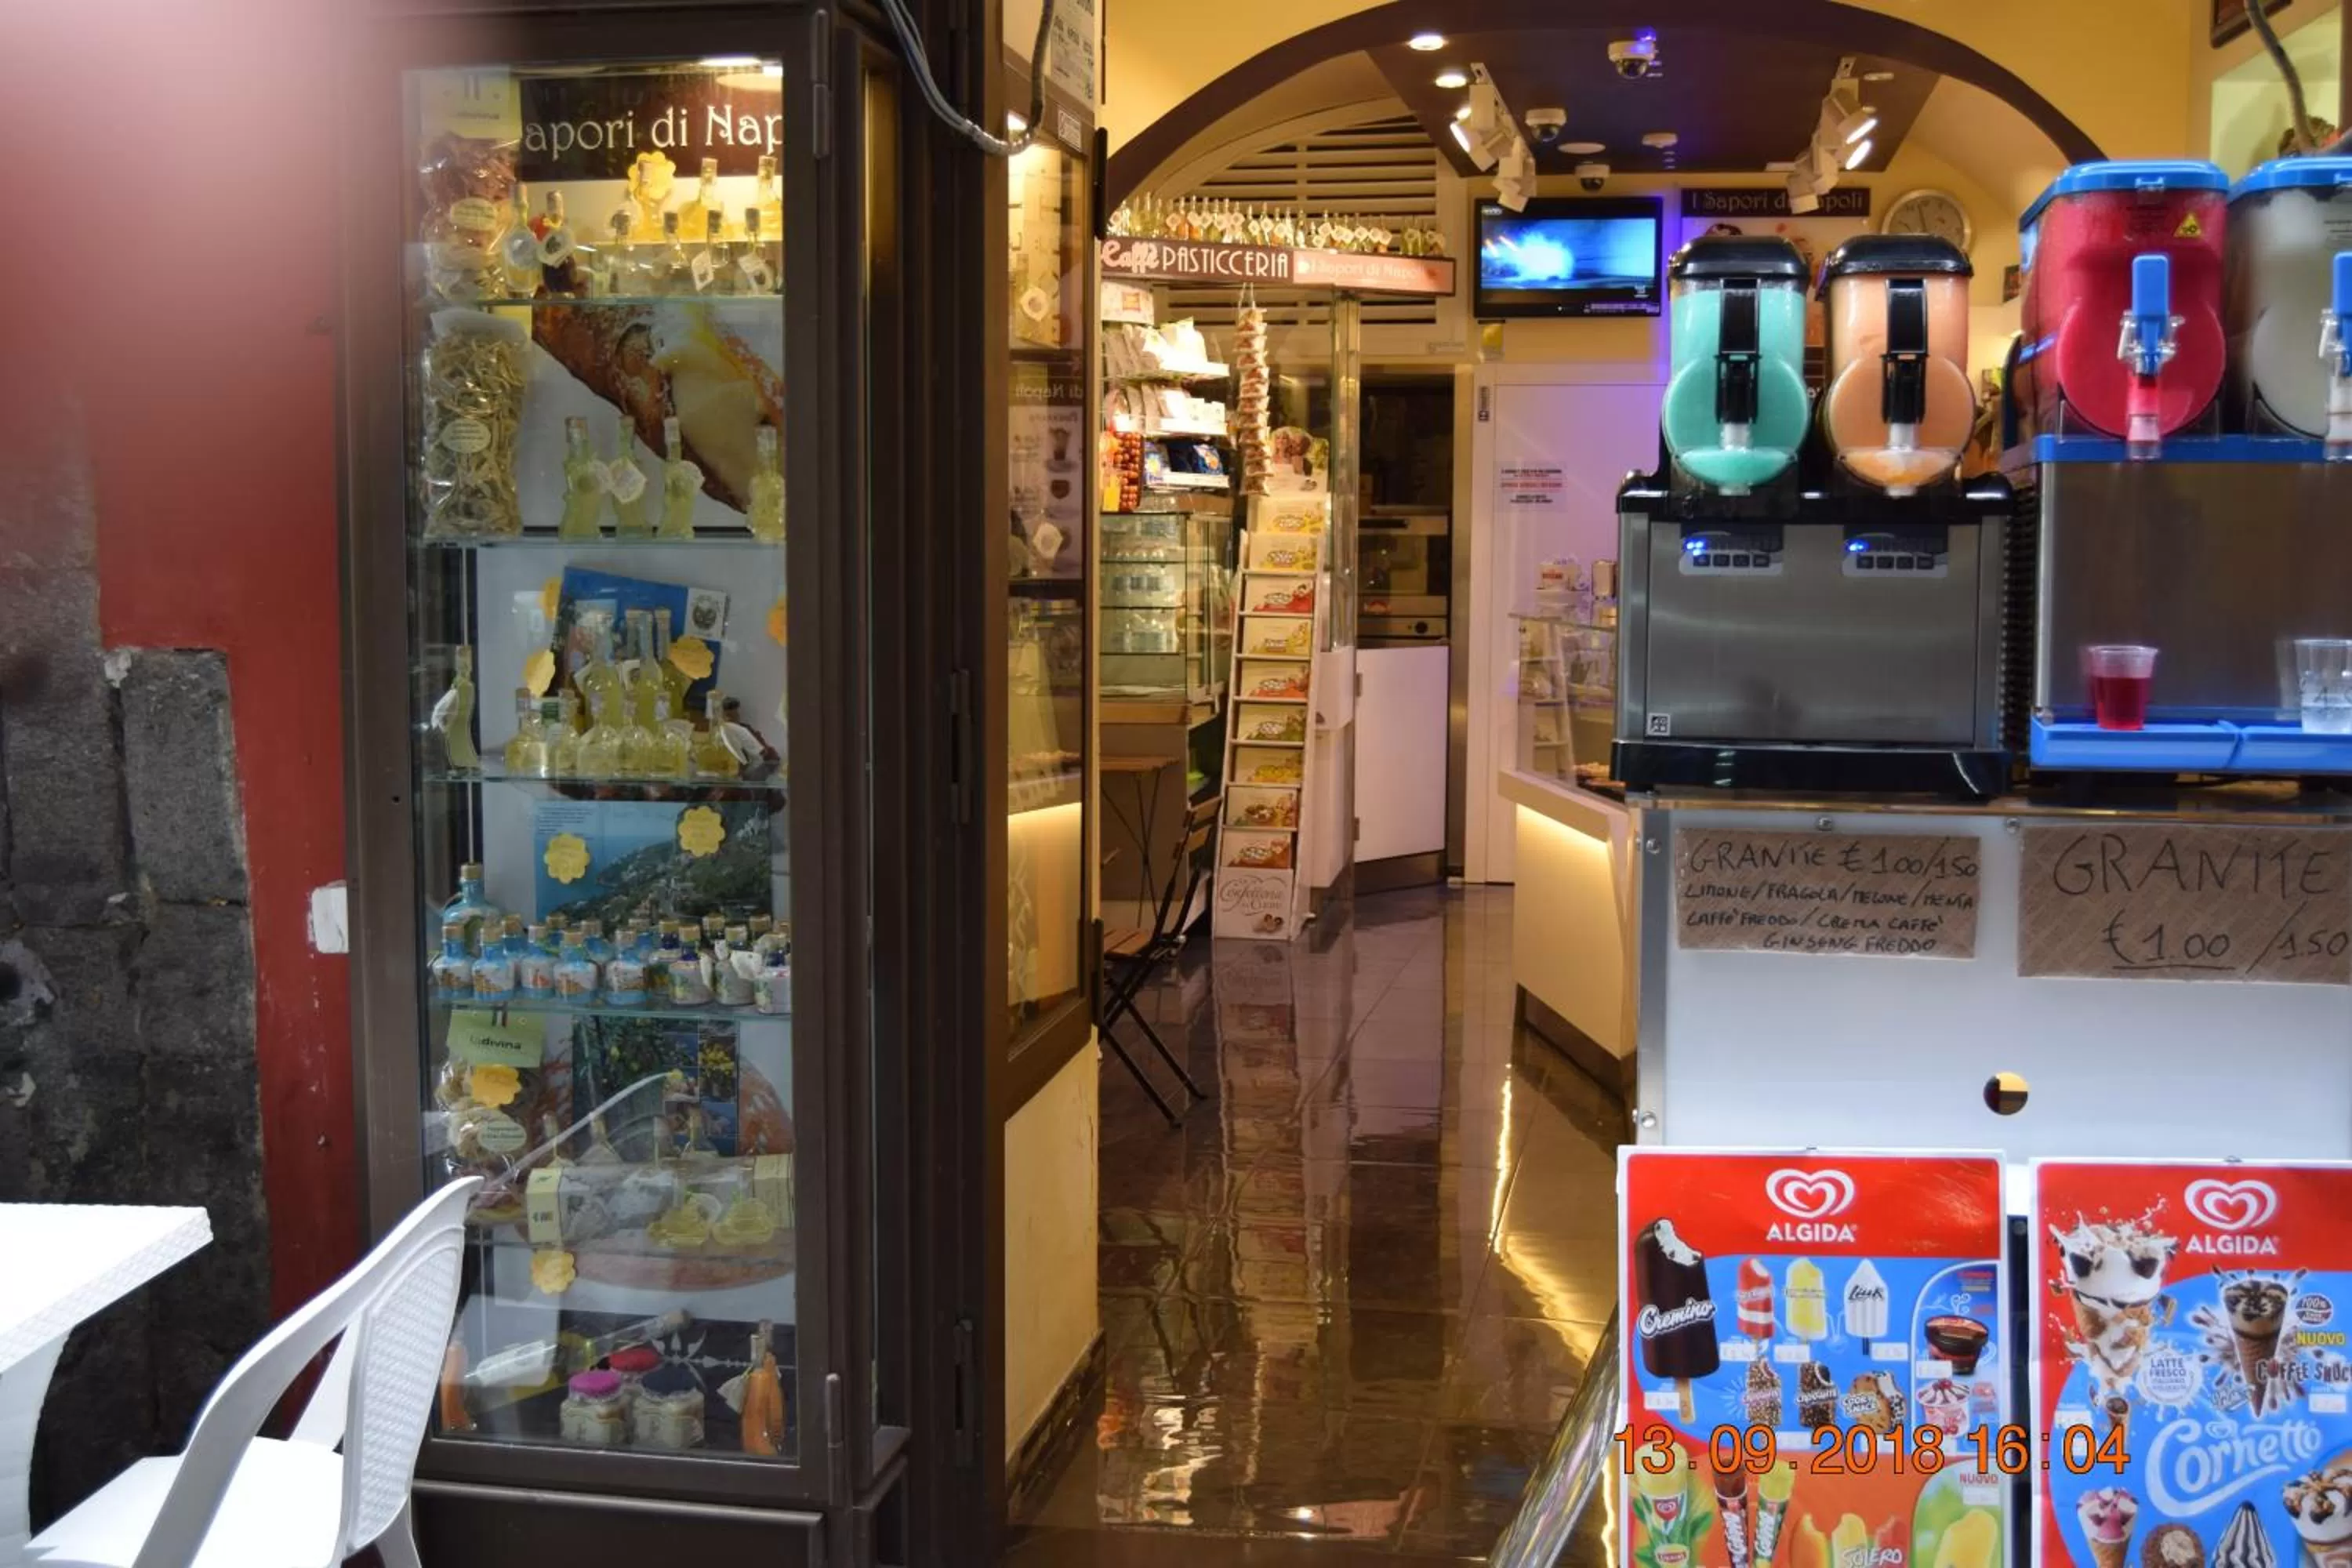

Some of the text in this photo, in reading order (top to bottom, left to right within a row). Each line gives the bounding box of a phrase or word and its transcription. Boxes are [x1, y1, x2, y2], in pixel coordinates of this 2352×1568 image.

[524, 104, 783, 162] apori di Nap
[1704, 192, 1766, 212] Sapori
[1102, 239, 1289, 278] Caffè PASTICCERIA
[1690, 838, 1826, 873] GRANITE
[2053, 833, 2333, 901] GRANITE
[1865, 936, 1936, 953] FREDDO
[1766, 1222, 1855, 1243] ALGIDA
[2184, 1234, 2278, 1255] ALGIDA
[1638, 1298, 1716, 1338] Cremino
[2296, 1331, 2347, 1346] NUOVO
[2149, 1369, 2187, 1377] FRESCO
[2150, 1357, 2184, 1368] LATTE
[2314, 1360, 2352, 1383] SHOC
[2146, 1417, 2322, 1517] Cornetto
[1959, 1473, 1998, 1485] NUOVO
